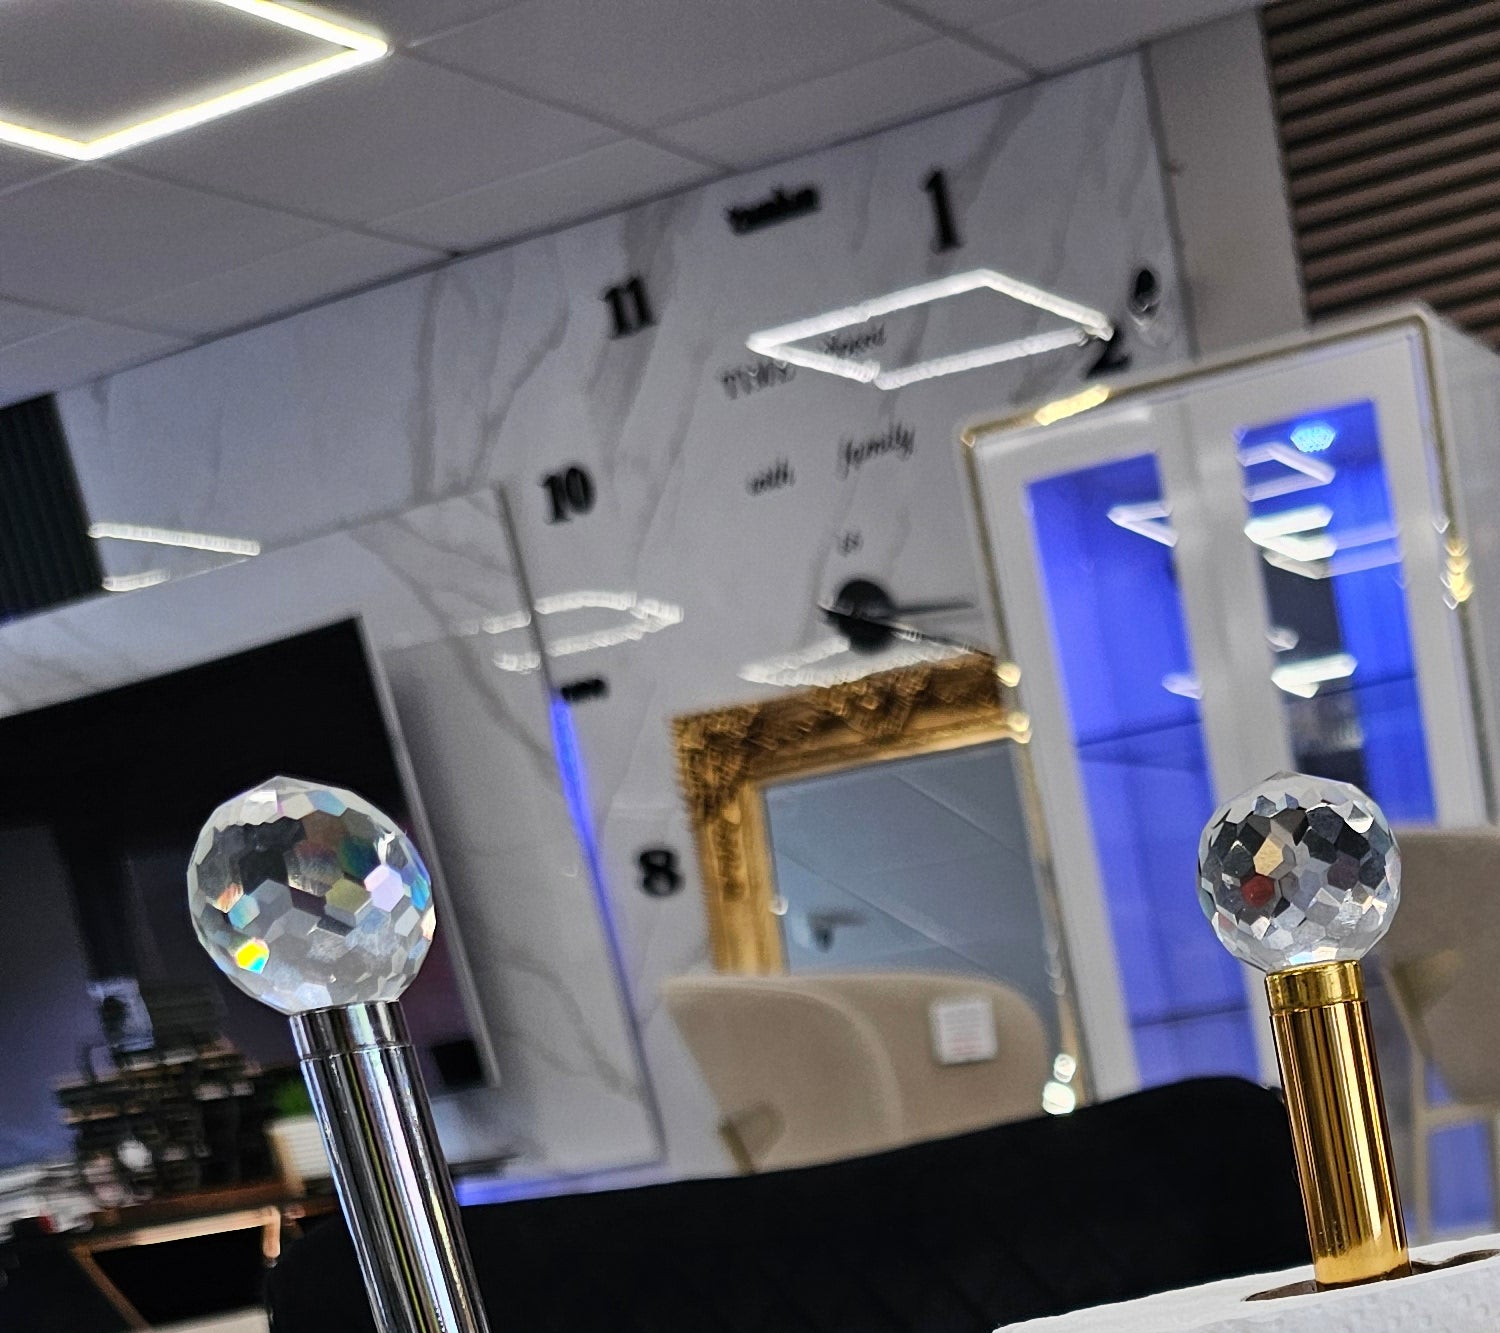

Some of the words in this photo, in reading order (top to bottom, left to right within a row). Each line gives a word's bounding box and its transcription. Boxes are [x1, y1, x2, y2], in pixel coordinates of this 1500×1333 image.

[920, 168, 963, 252] 1
[602, 274, 655, 338] 11
[539, 465, 597, 525] 10
[636, 847, 686, 899] 8
